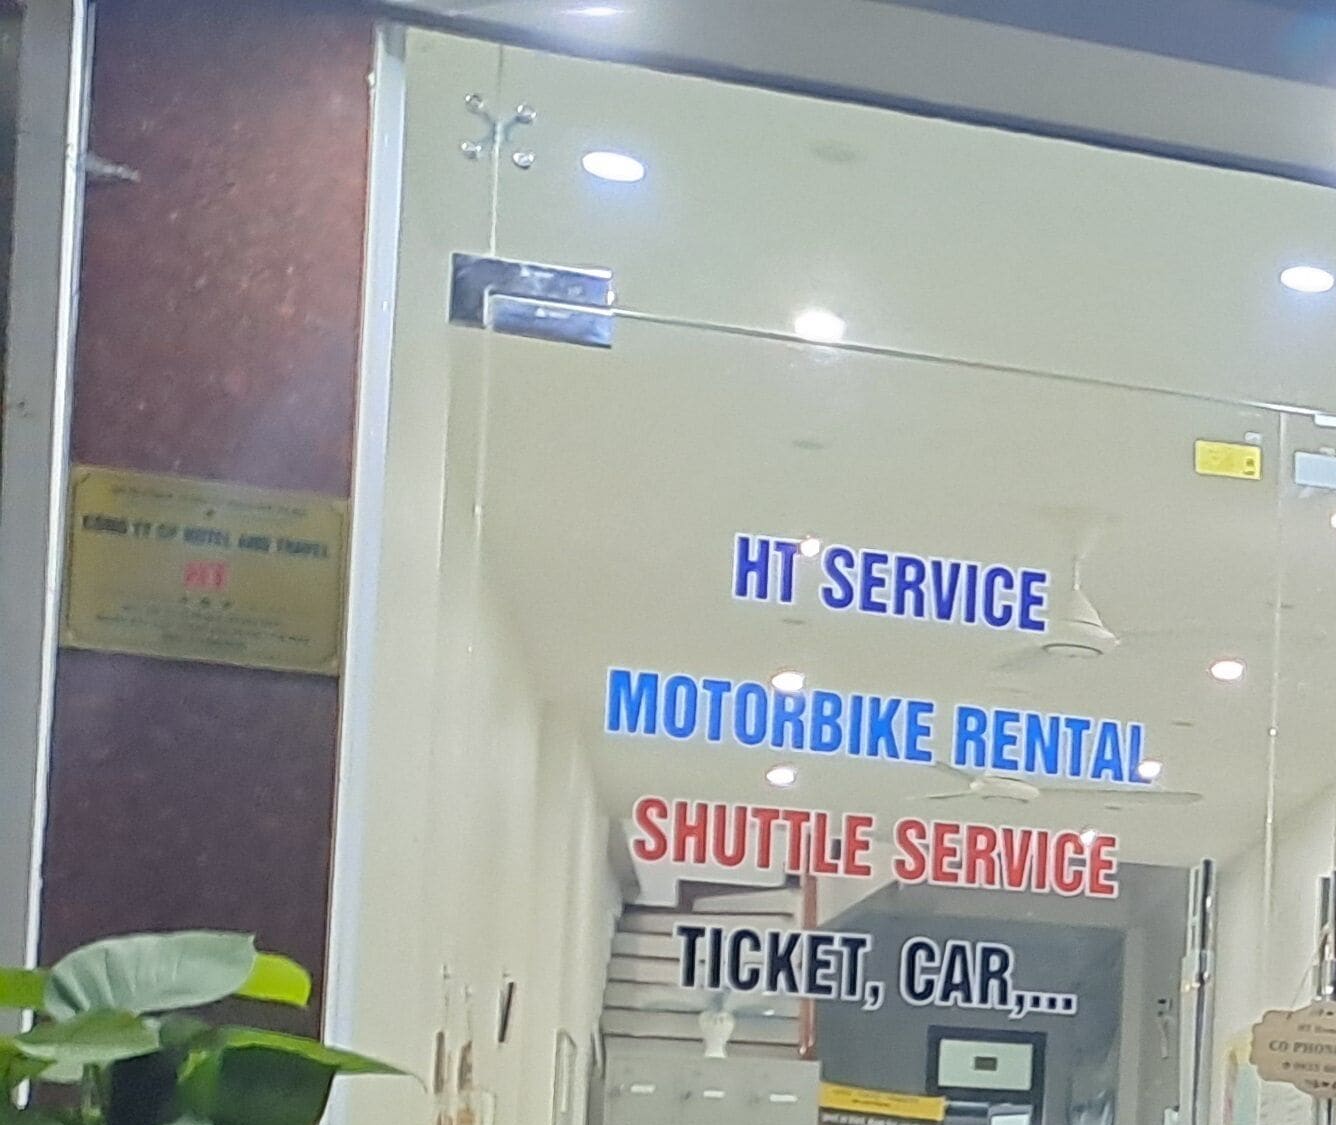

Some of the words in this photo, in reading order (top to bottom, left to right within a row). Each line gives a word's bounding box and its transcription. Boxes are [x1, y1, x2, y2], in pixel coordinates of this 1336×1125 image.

[734, 535, 800, 603] HT
[820, 545, 1050, 632] SERVICE
[606, 668, 936, 763] MOTORBIKE
[953, 703, 1154, 786] RENTAL
[632, 796, 874, 876] SHUTTLE
[893, 817, 1117, 897] SERVICE
[675, 923, 885, 1009] TICKET,
[902, 935, 1075, 1018] CAR,...
